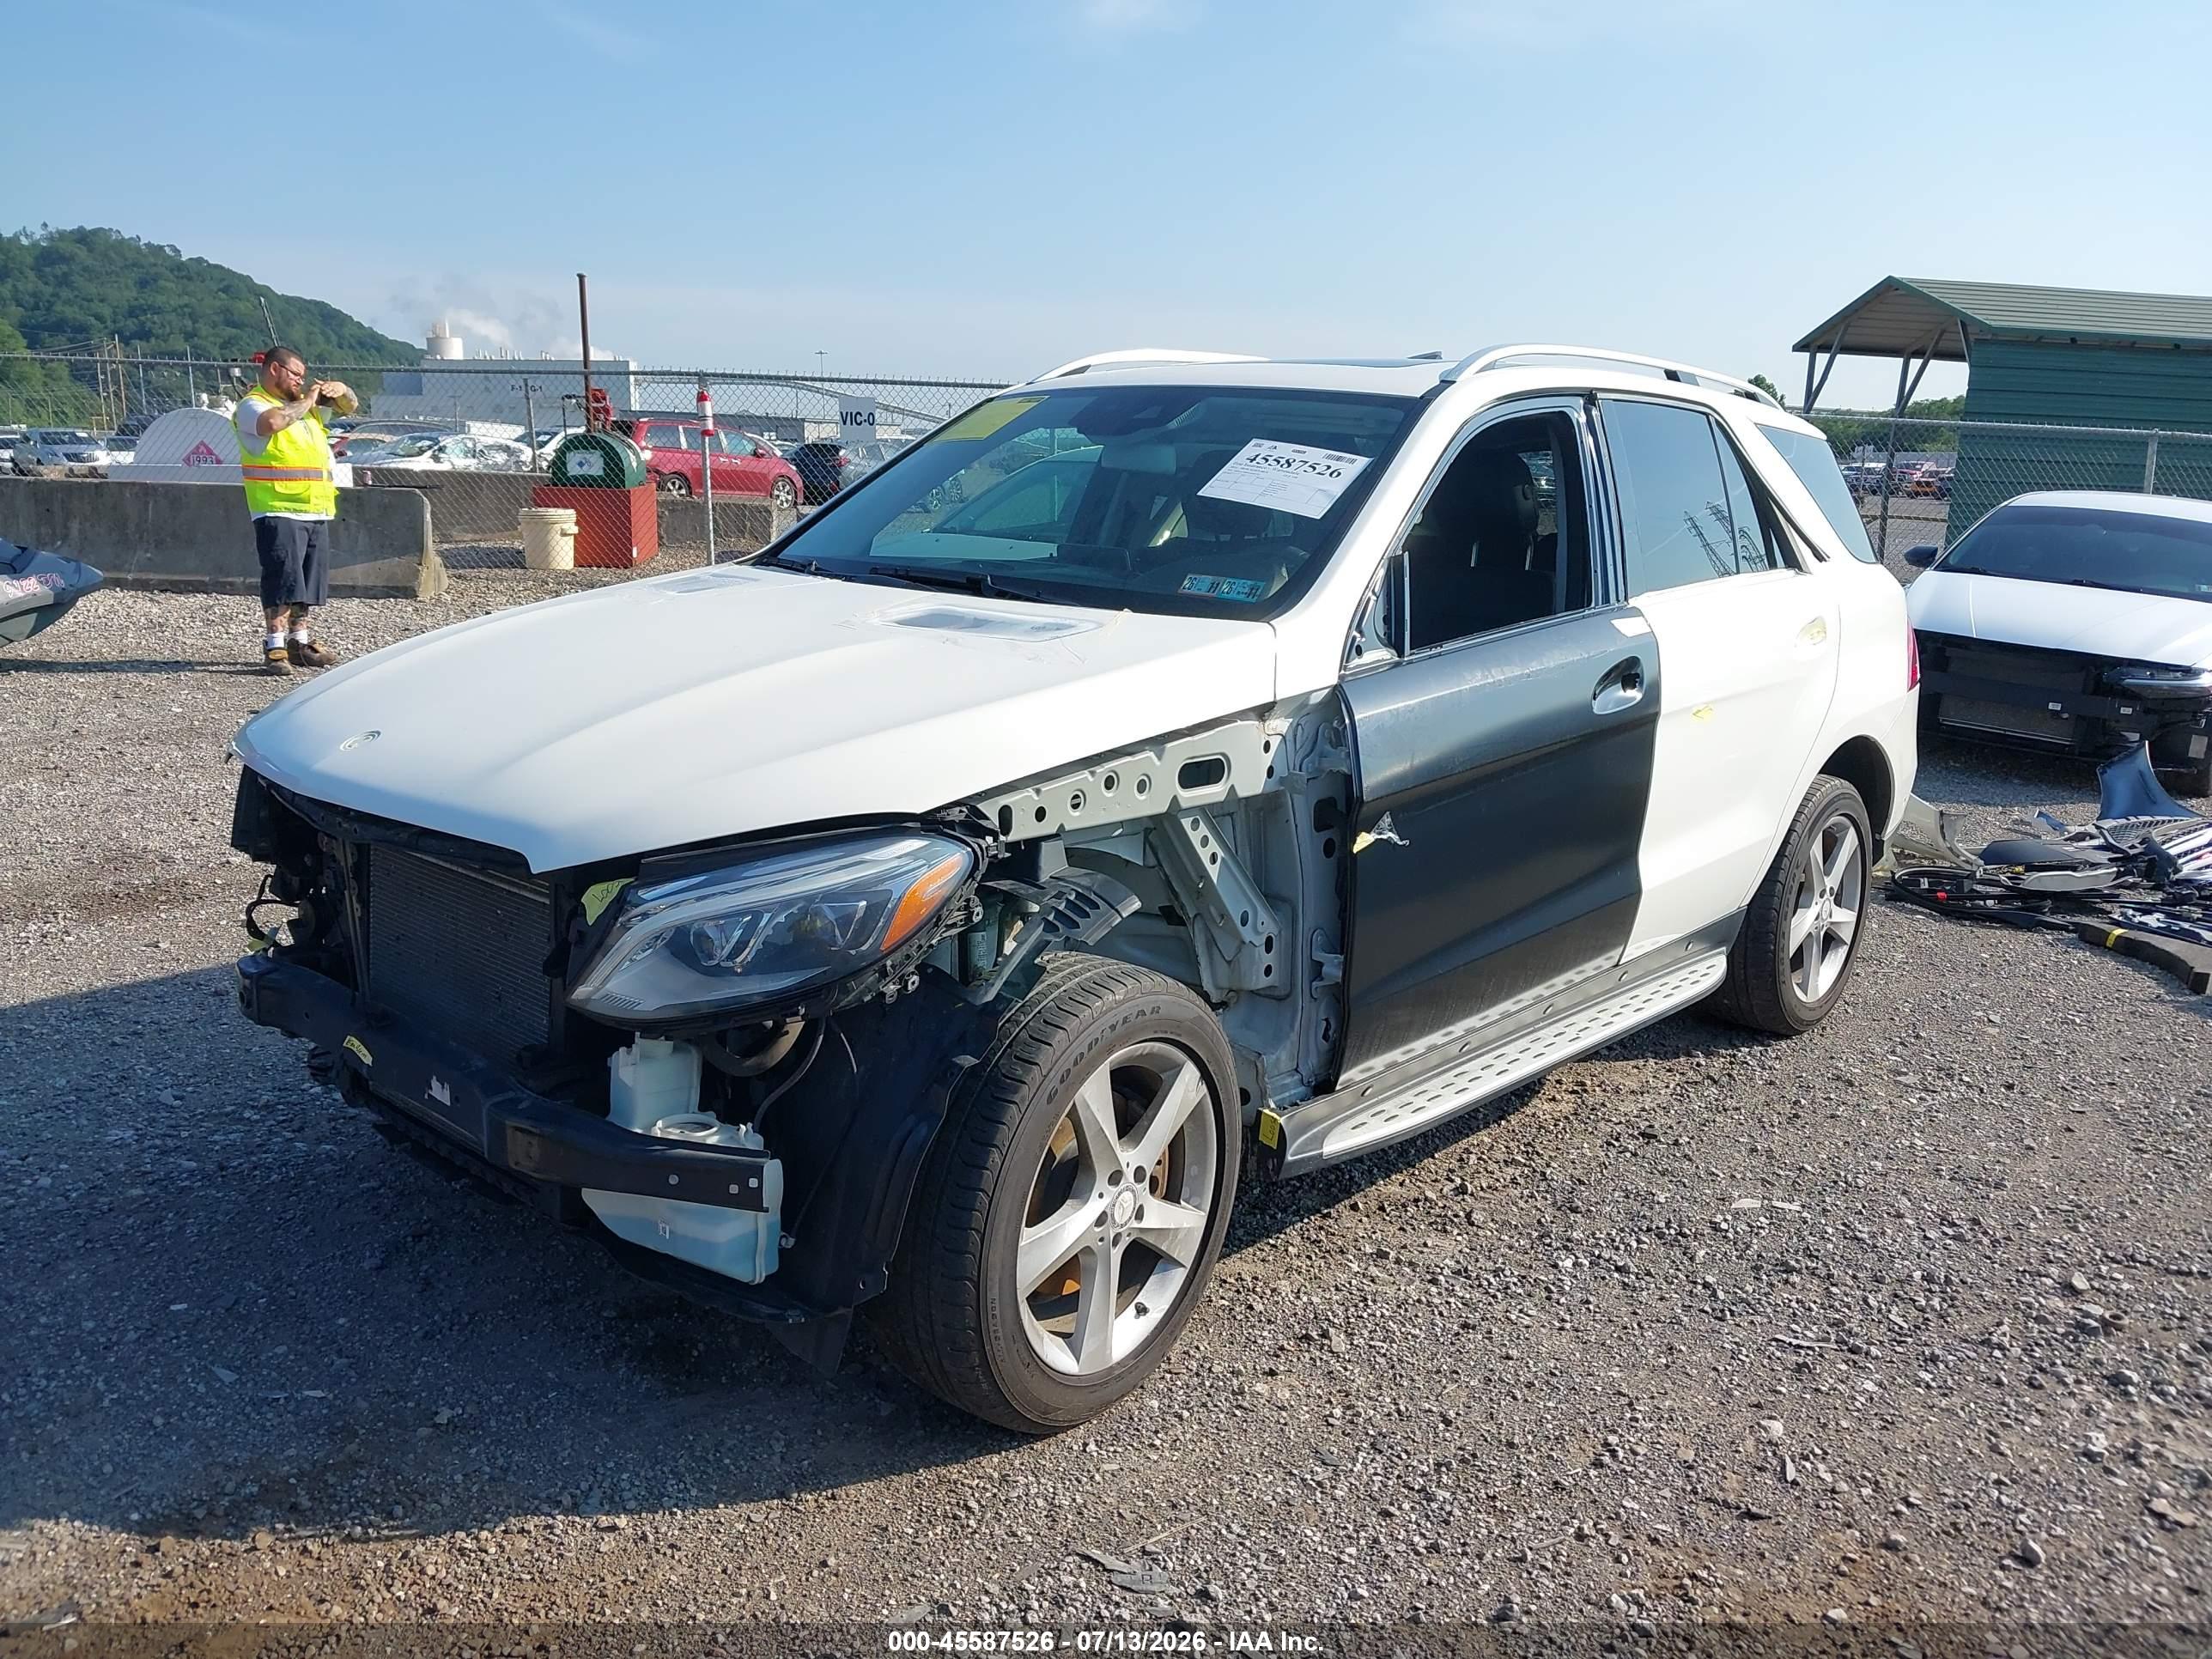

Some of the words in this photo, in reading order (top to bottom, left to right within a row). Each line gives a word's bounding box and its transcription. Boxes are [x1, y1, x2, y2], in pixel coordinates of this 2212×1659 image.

[191, 455, 214, 466] 1993
[1245, 453, 1346, 479] 45587526
[1045, 1005, 1162, 1105] GOODYEAR
